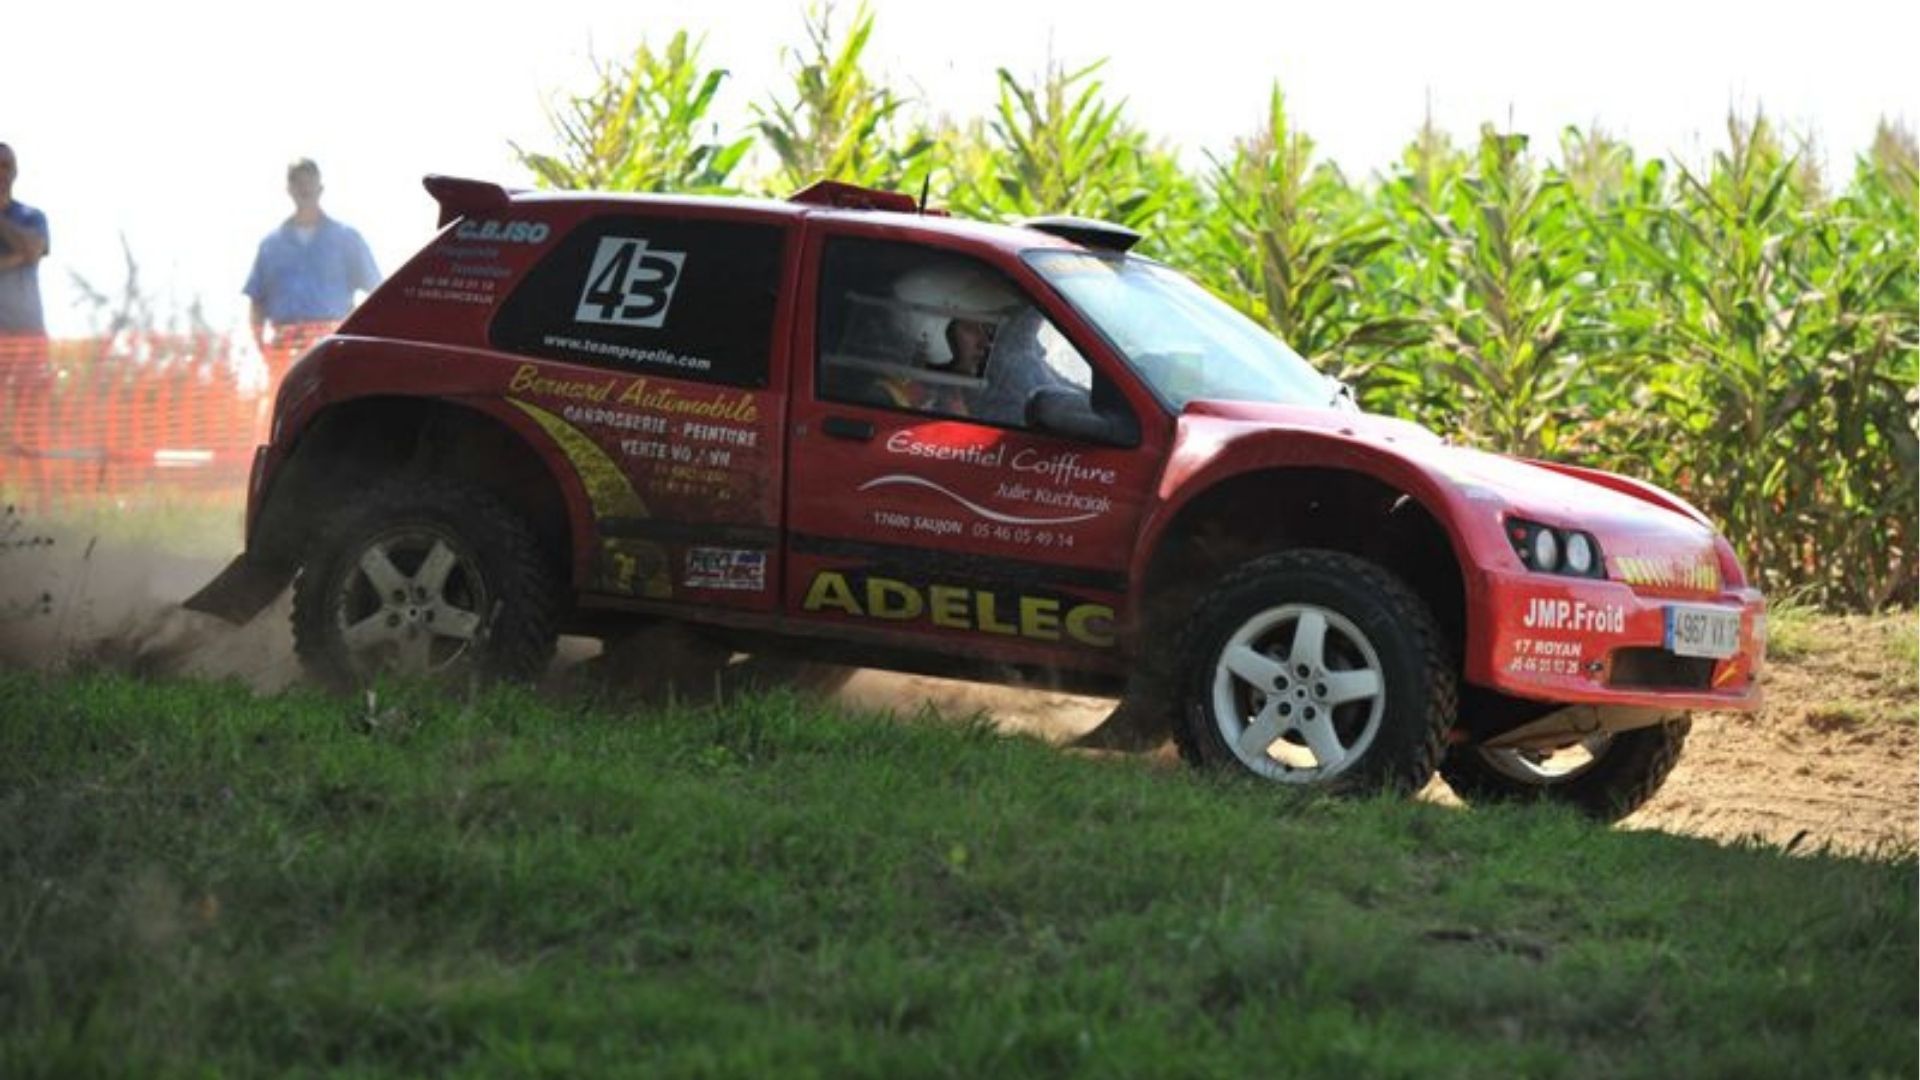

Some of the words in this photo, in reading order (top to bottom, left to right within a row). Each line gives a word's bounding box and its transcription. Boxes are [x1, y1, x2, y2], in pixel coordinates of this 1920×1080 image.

[457, 220, 549, 243] C.B.ISO
[584, 241, 678, 321] 43
[509, 363, 618, 399] Bernard
[616, 378, 758, 422] Automobile
[621, 439, 666, 460] VENTE
[683, 422, 757, 447] PEINTURE
[886, 429, 1004, 467] Essentiel
[1011, 449, 1116, 485] Coiffure
[913, 515, 963, 535] SAUJON
[972, 522, 990, 538] 05
[993, 524, 1011, 541] 46
[803, 570, 1116, 648] ADELEC
[1523, 598, 1625, 633] JMP.Froid
[1514, 638, 1531, 654] 17
[1534, 640, 1582, 657] ROYAN
